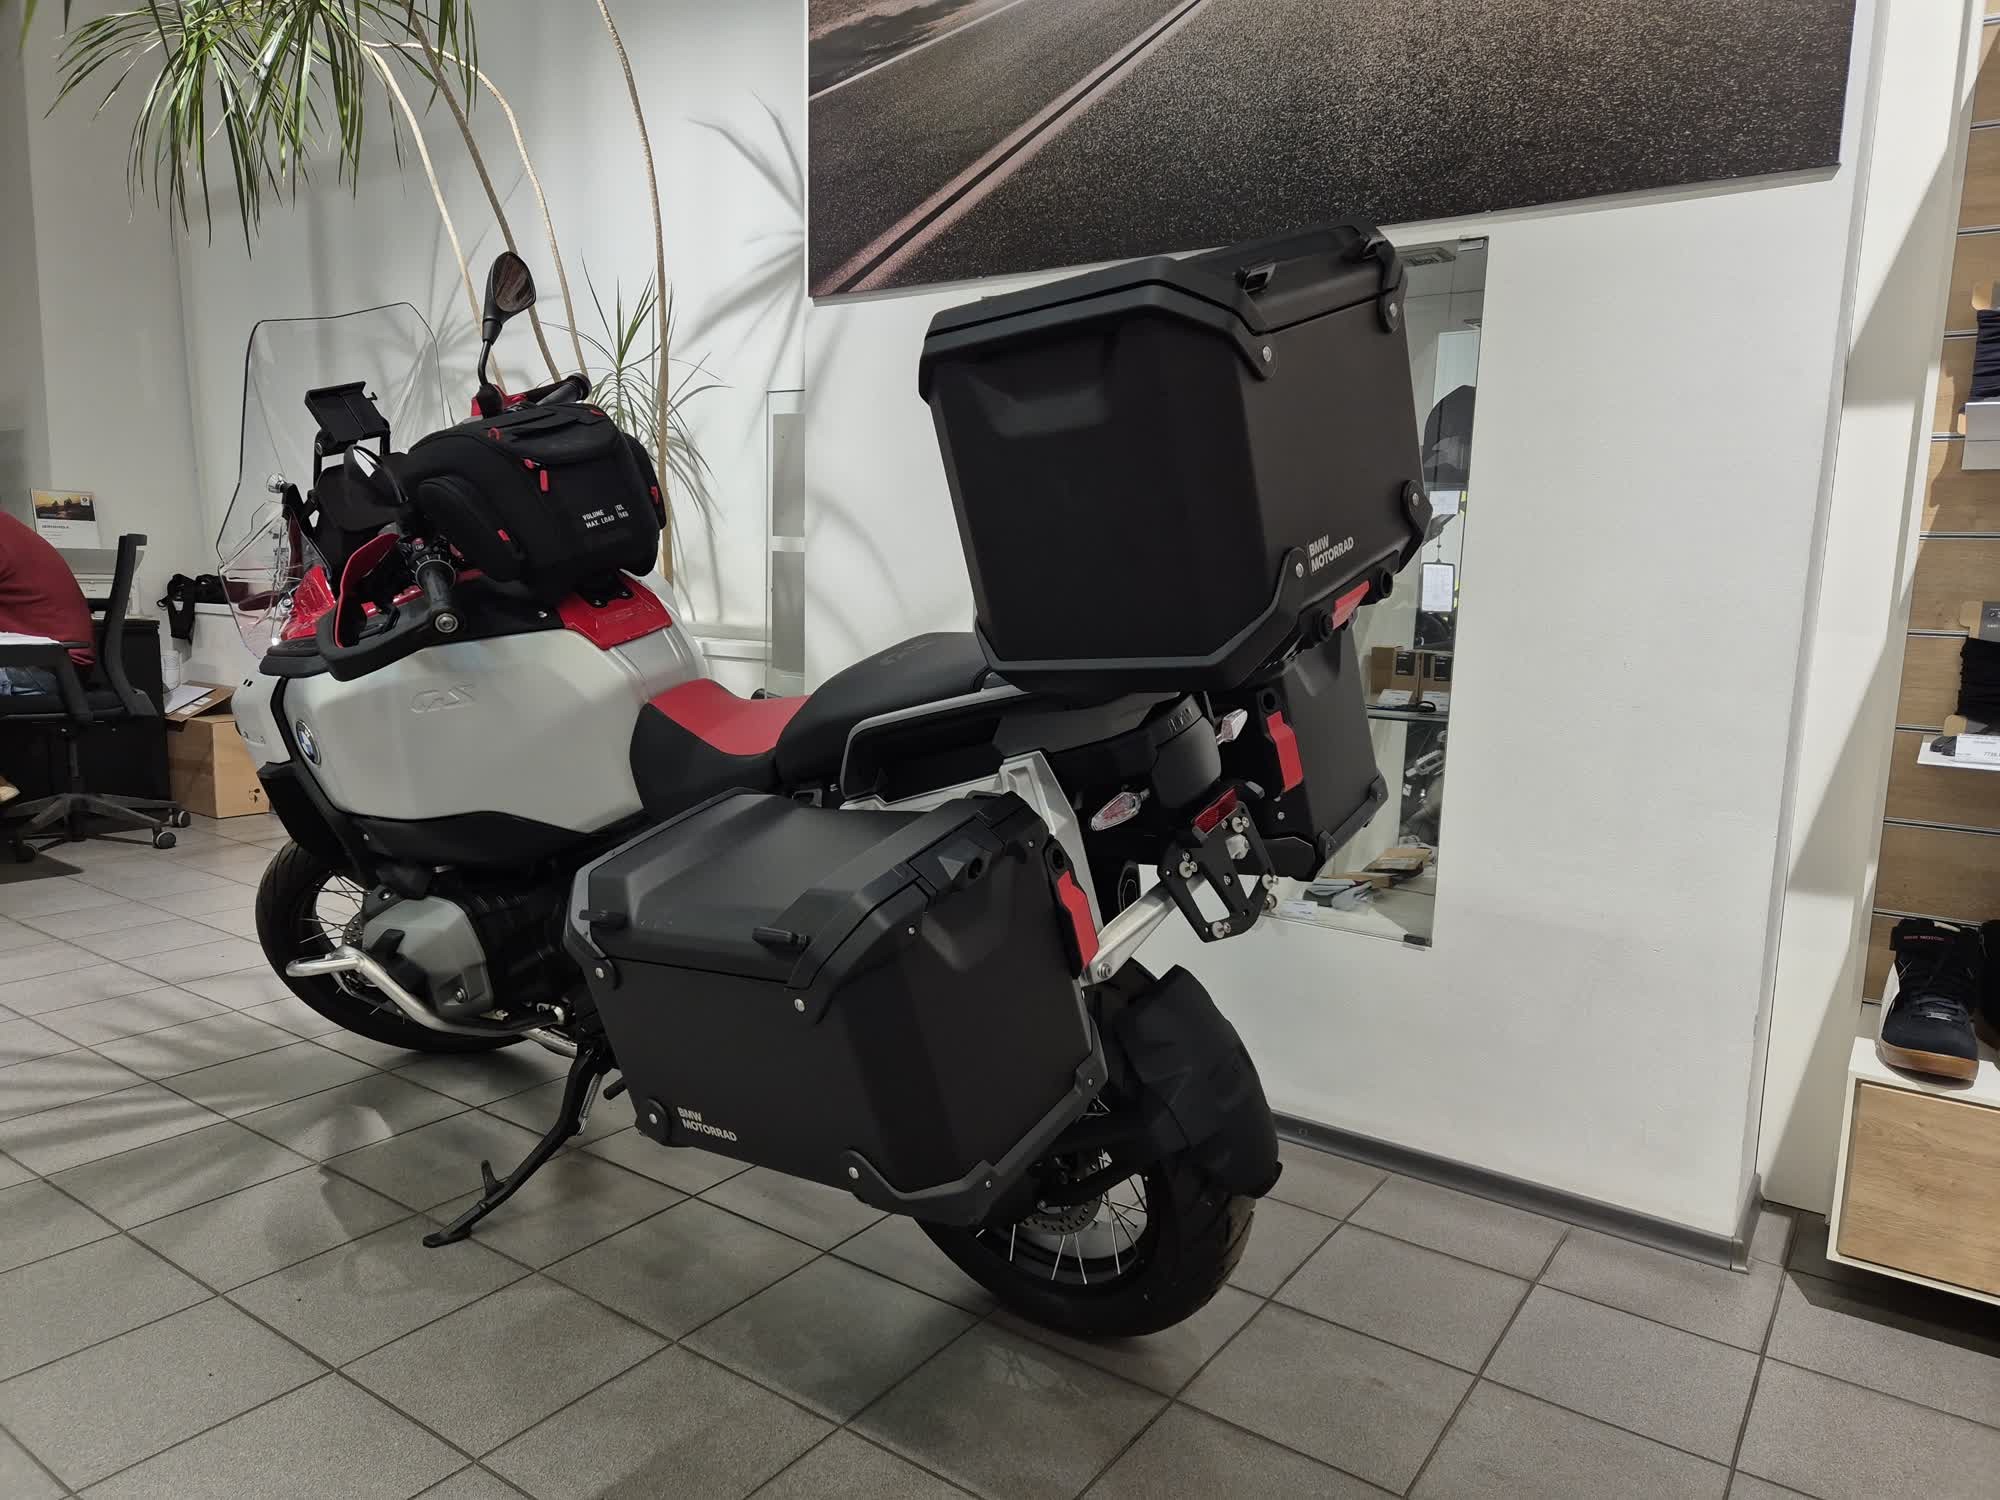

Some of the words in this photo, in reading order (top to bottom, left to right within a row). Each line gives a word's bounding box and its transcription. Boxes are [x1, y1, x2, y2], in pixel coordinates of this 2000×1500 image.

[582, 509, 604, 521] VOLUME
[600, 514, 615, 524] LOAD
[1309, 534, 1329, 558] BMW
[1310, 536, 1354, 573] MOTORRAD
[677, 1106, 703, 1122] BMW
[681, 1118, 738, 1142] MOTORRAD
